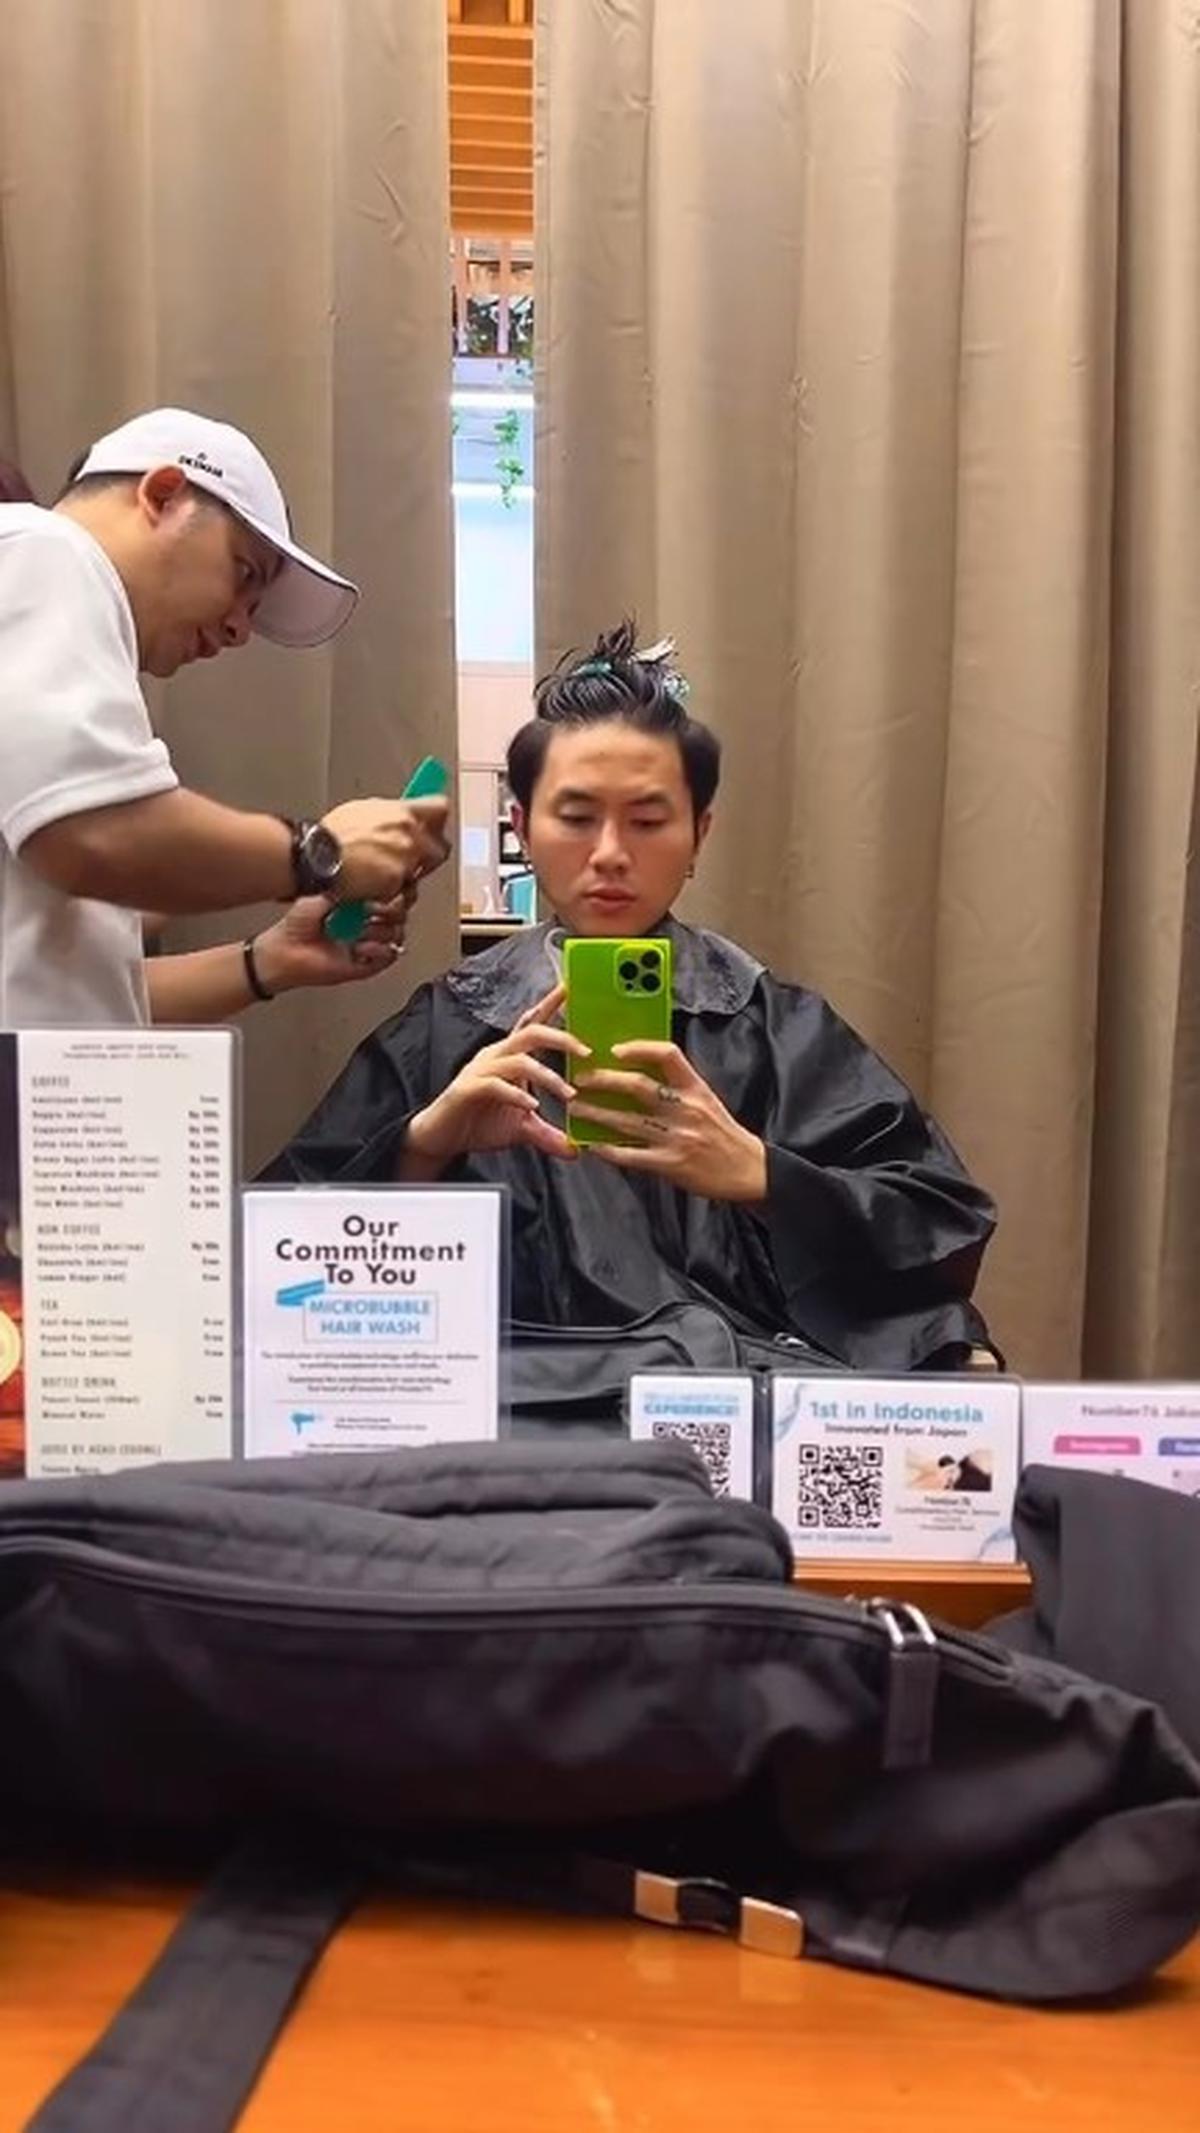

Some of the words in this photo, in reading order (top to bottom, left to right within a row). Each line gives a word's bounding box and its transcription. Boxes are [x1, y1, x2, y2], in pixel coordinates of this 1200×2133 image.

[342, 1215, 399, 1238] Our
[275, 1238, 466, 1262] Commitment
[324, 1263, 354, 1285] To
[366, 1263, 417, 1285] You
[310, 1299, 431, 1315] MICROBUBBLE
[320, 1319, 362, 1334] HAIR
[368, 1320, 421, 1335] WASH
[809, 1402, 838, 1418] 1st
[846, 1402, 866, 1419] in
[874, 1402, 984, 1423] Indonesia
[825, 1423, 889, 1435] Innovated
[894, 1425, 924, 1436] from
[927, 1426, 967, 1438] Japan
